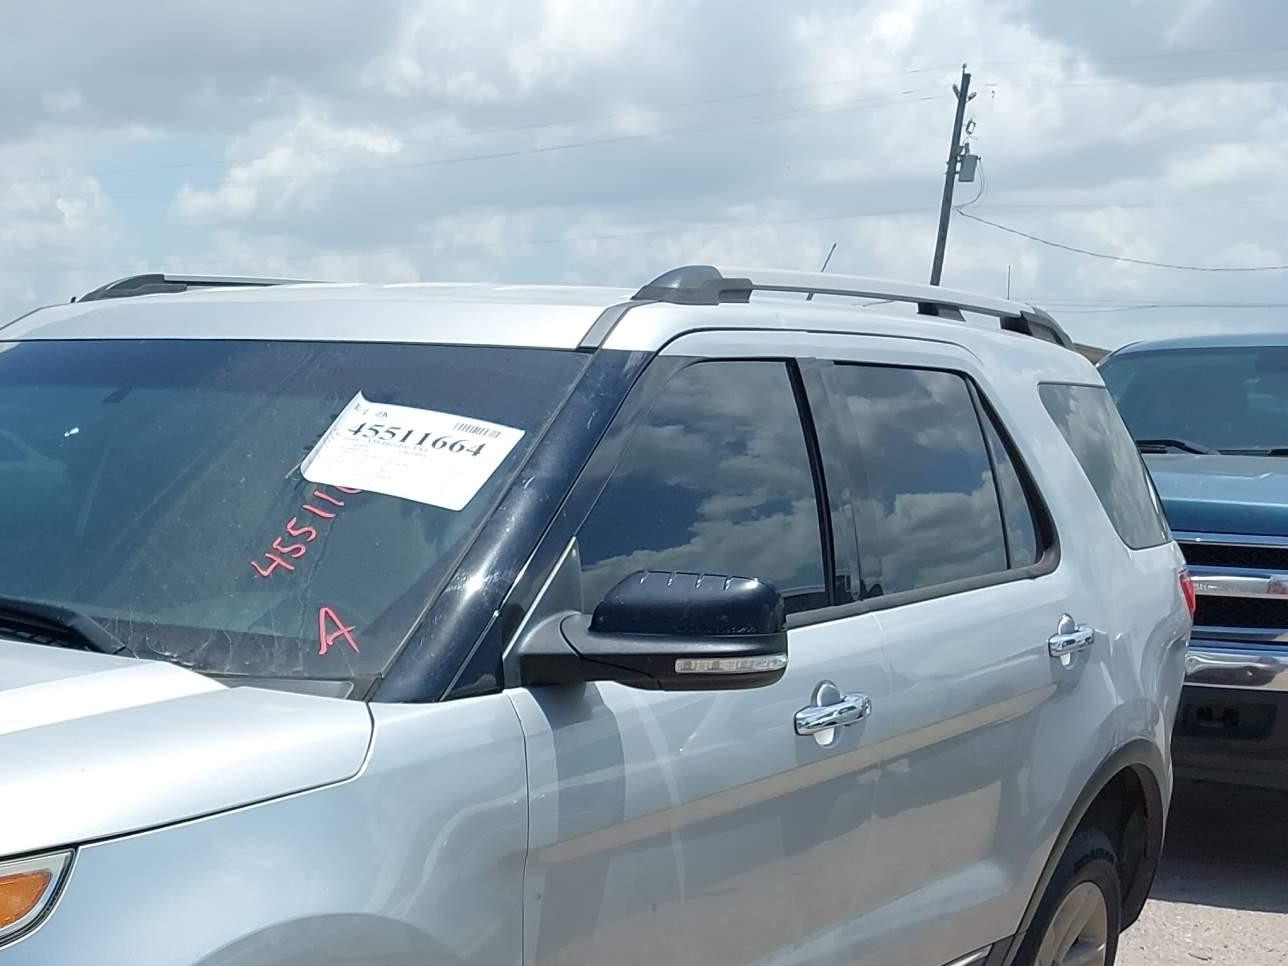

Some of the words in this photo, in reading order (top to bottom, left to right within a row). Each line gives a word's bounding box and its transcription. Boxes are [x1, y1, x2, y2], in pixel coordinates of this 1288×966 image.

[347, 421, 487, 457] 45511664
[250, 485, 363, 579] 45511
[318, 606, 360, 656] A
